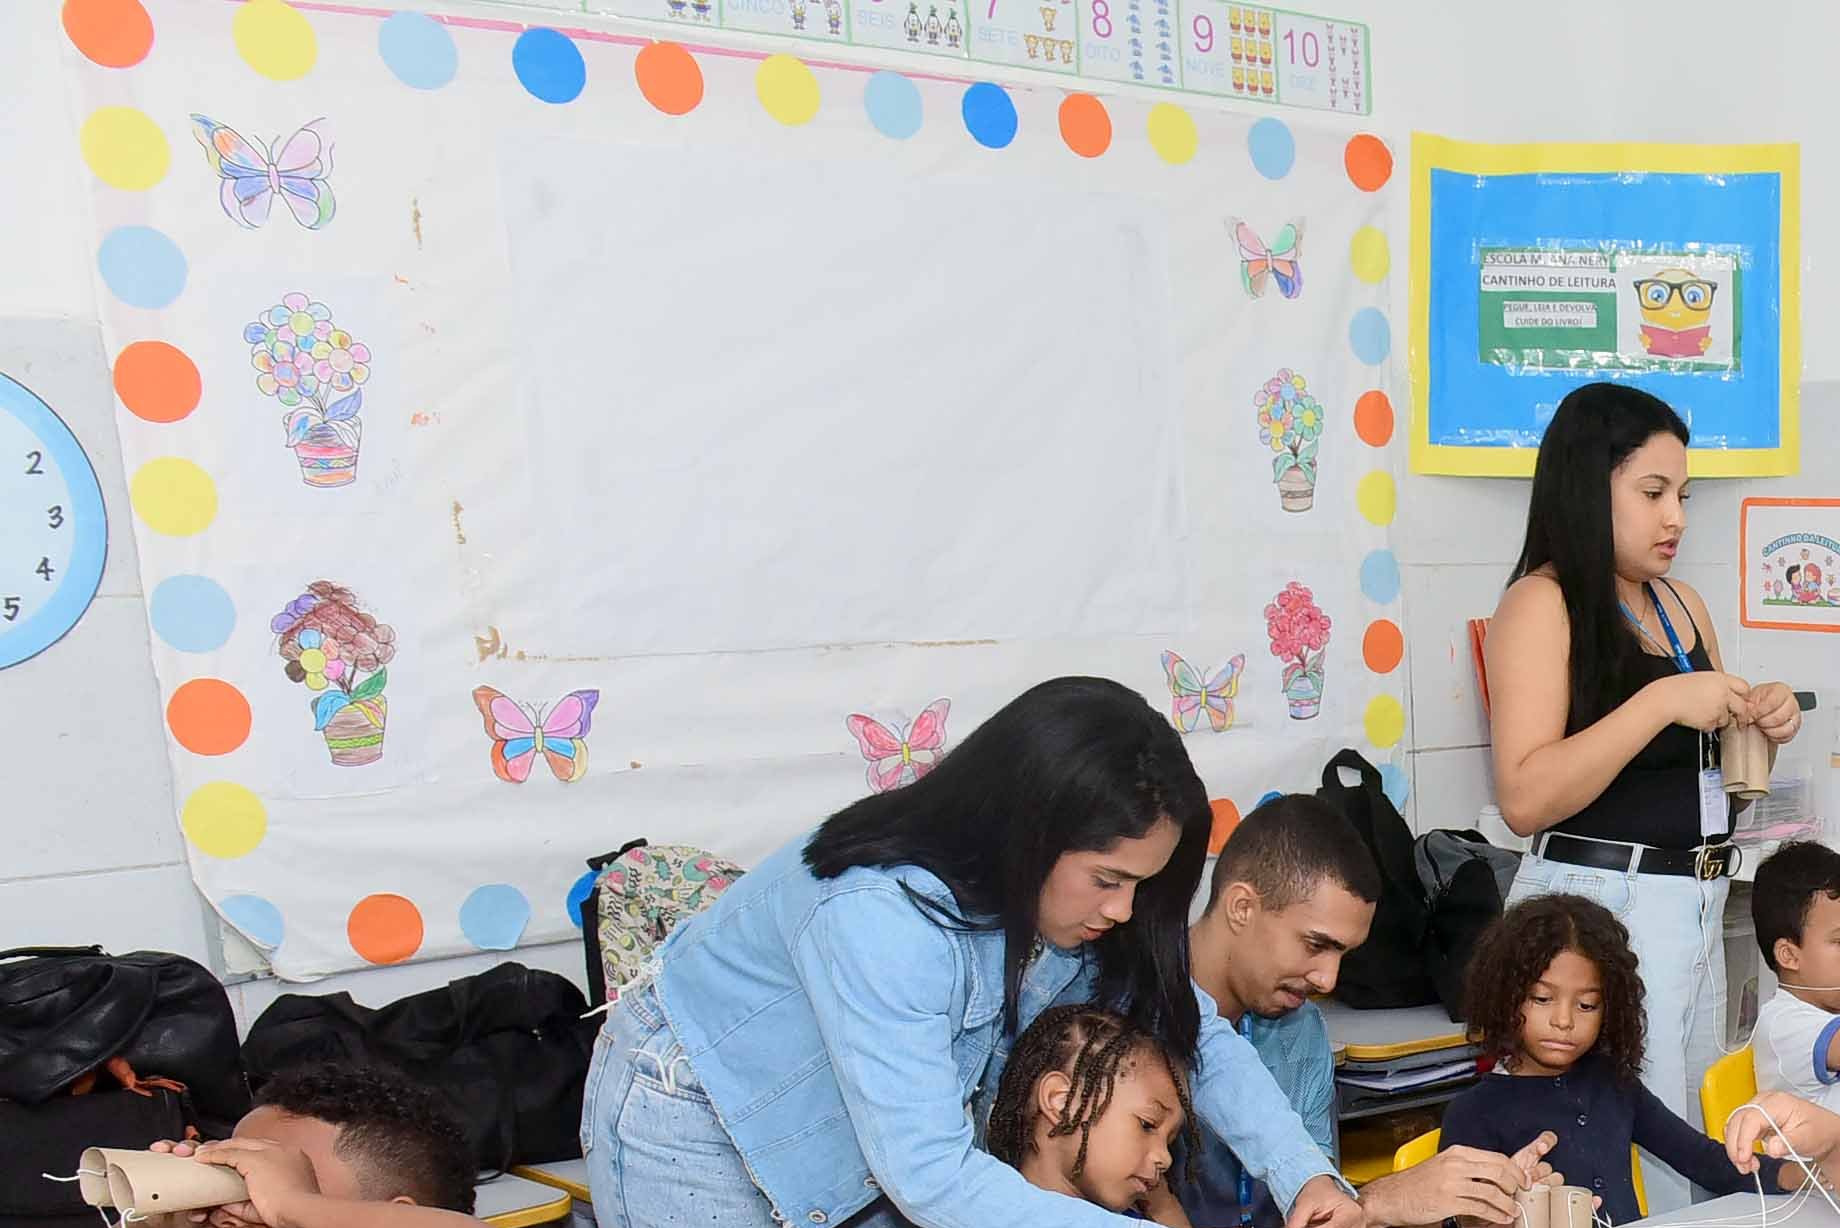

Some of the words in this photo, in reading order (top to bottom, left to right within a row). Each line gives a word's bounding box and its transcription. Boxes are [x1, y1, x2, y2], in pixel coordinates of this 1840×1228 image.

[1092, 0, 1112, 38] 8
[1193, 14, 1214, 53] 9
[1283, 28, 1320, 68] 10
[1482, 275, 1545, 286] CANTINHO
[1549, 276, 1565, 287] DE
[1568, 277, 1616, 288] LEITURA
[25, 450, 43, 475] 2
[47, 505, 64, 529] 3
[35, 556, 55, 581] 4
[2, 597, 20, 621] 5
